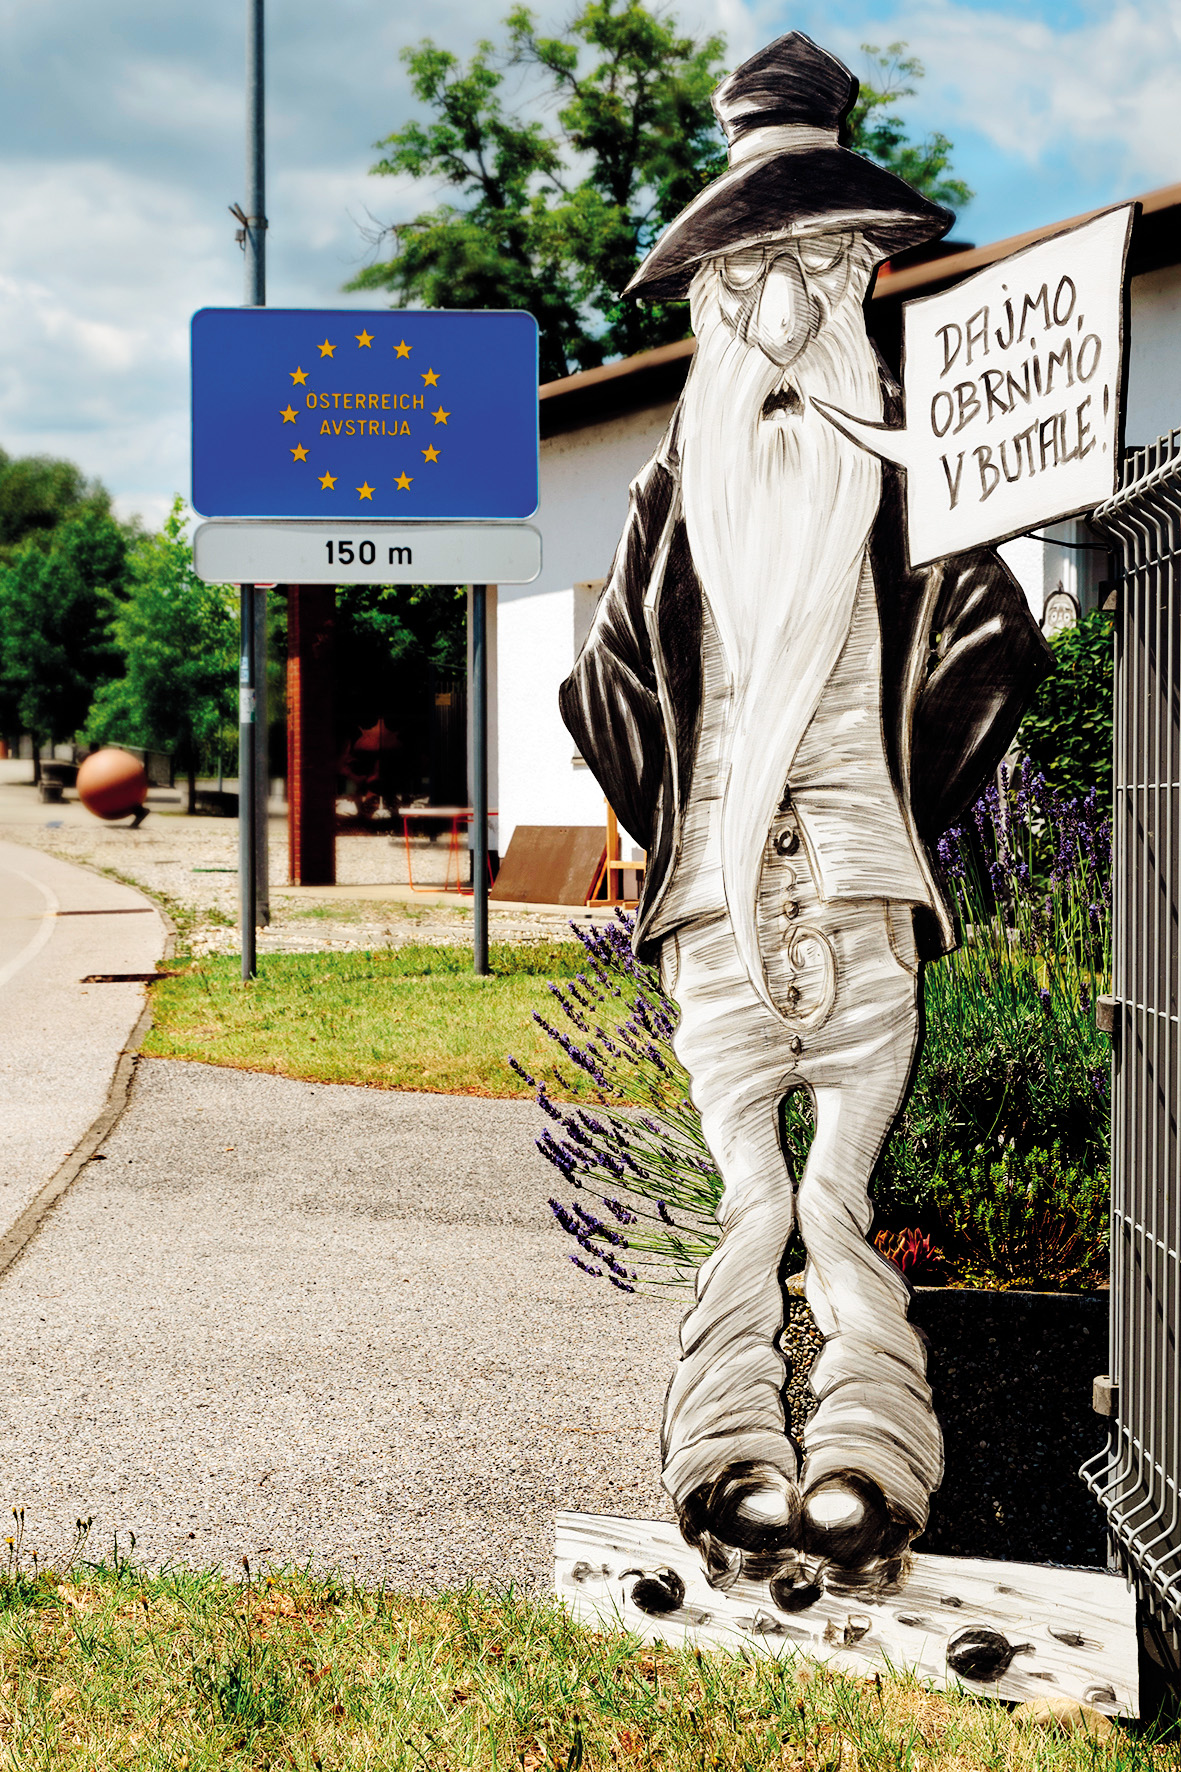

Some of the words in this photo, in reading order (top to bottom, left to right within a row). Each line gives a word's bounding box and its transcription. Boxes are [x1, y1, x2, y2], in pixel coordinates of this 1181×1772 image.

[930, 333, 1102, 439] OBRNIMO
[319, 419, 411, 436] AVSTRIJA
[938, 451, 966, 511] V
[325, 540, 376, 565] 150
[388, 546, 412, 565] m
